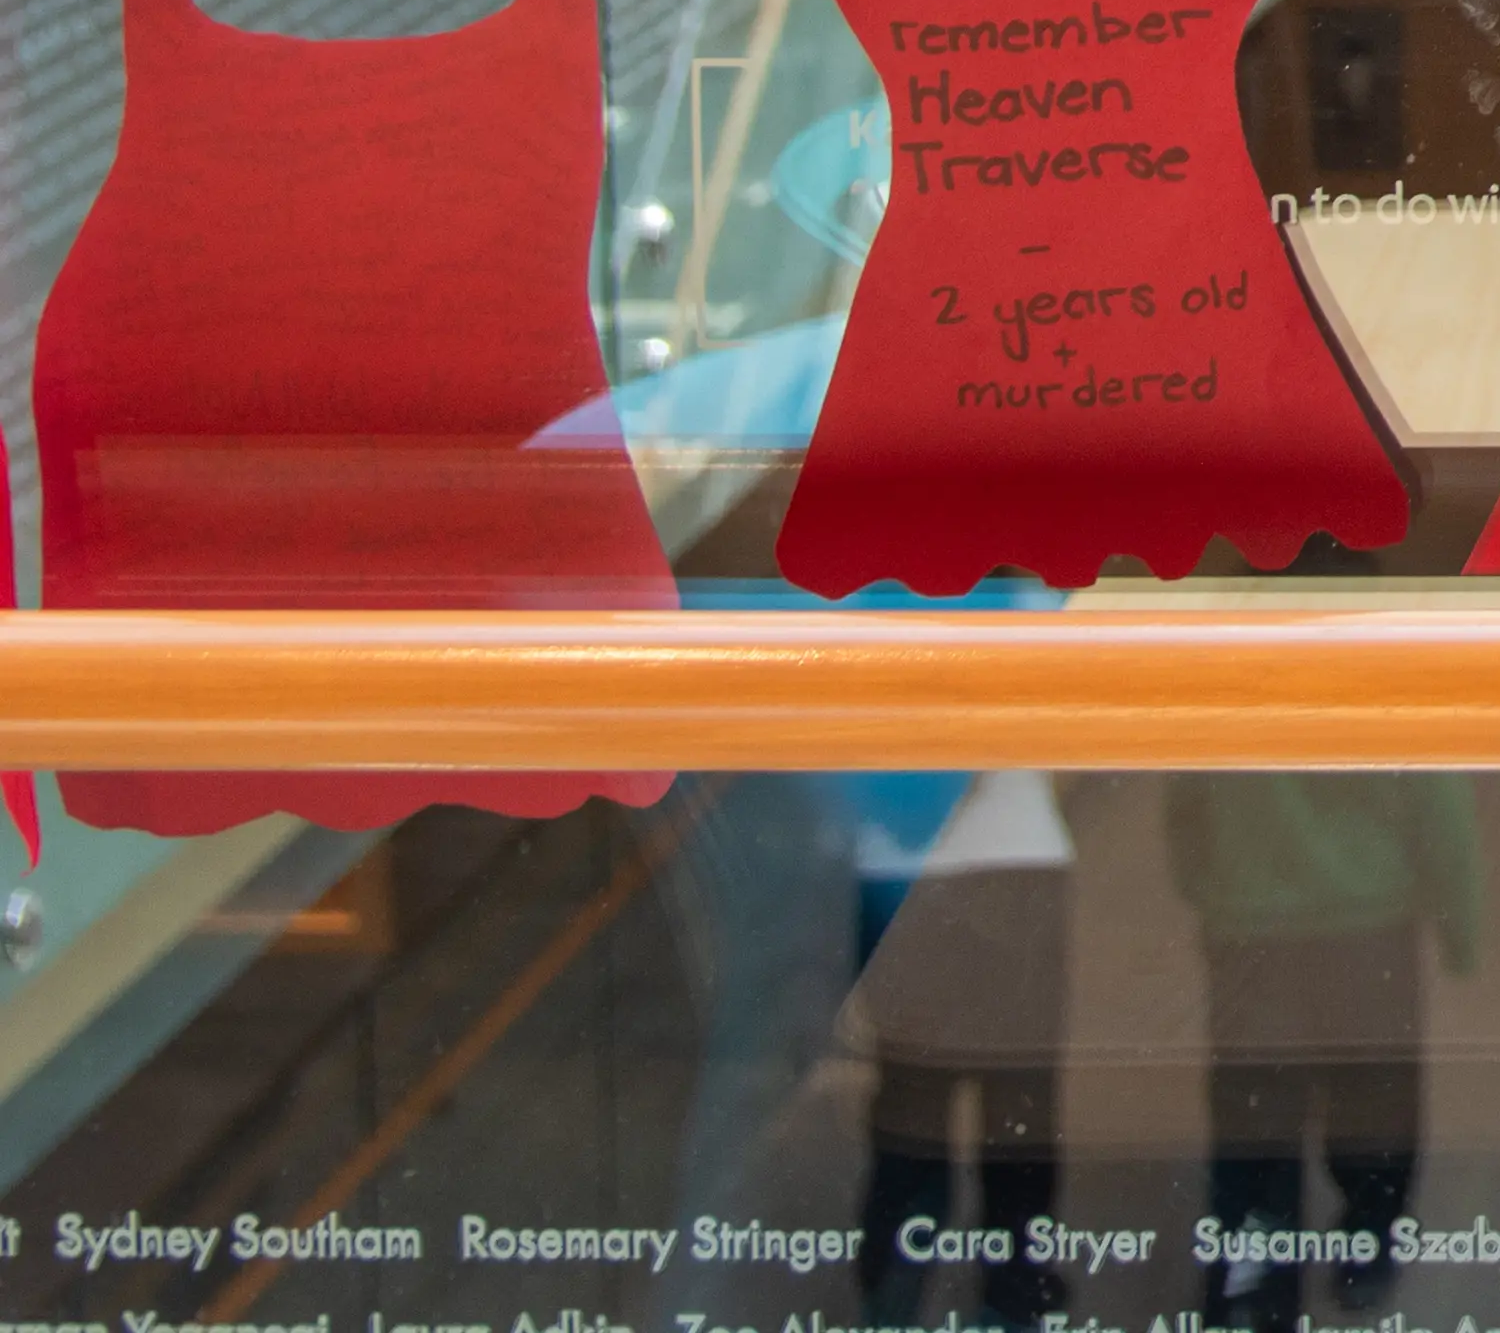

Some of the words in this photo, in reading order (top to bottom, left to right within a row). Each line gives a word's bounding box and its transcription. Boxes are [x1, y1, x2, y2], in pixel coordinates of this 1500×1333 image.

[890, 2, 1212, 55] remember
[907, 71, 1132, 126] Heaven
[900, 141, 1190, 195] Traverse
[1310, 186, 1361, 225] to
[1376, 179, 1437, 225] do
[931, 286, 967, 325] 2
[992, 282, 1156, 362] years
[1180, 271, 1249, 315] old
[957, 358, 1219, 409] murdered
[56, 1210, 218, 1272] Sydney
[231, 1211, 421, 1260] Southam
[460, 1214, 678, 1273] Rosemary
[691, 1213, 864, 1273] Stringer
[895, 1216, 1013, 1263] Cara
[1025, 1216, 1157, 1274] Stryer
[1192, 1217, 1378, 1264] Susanne
